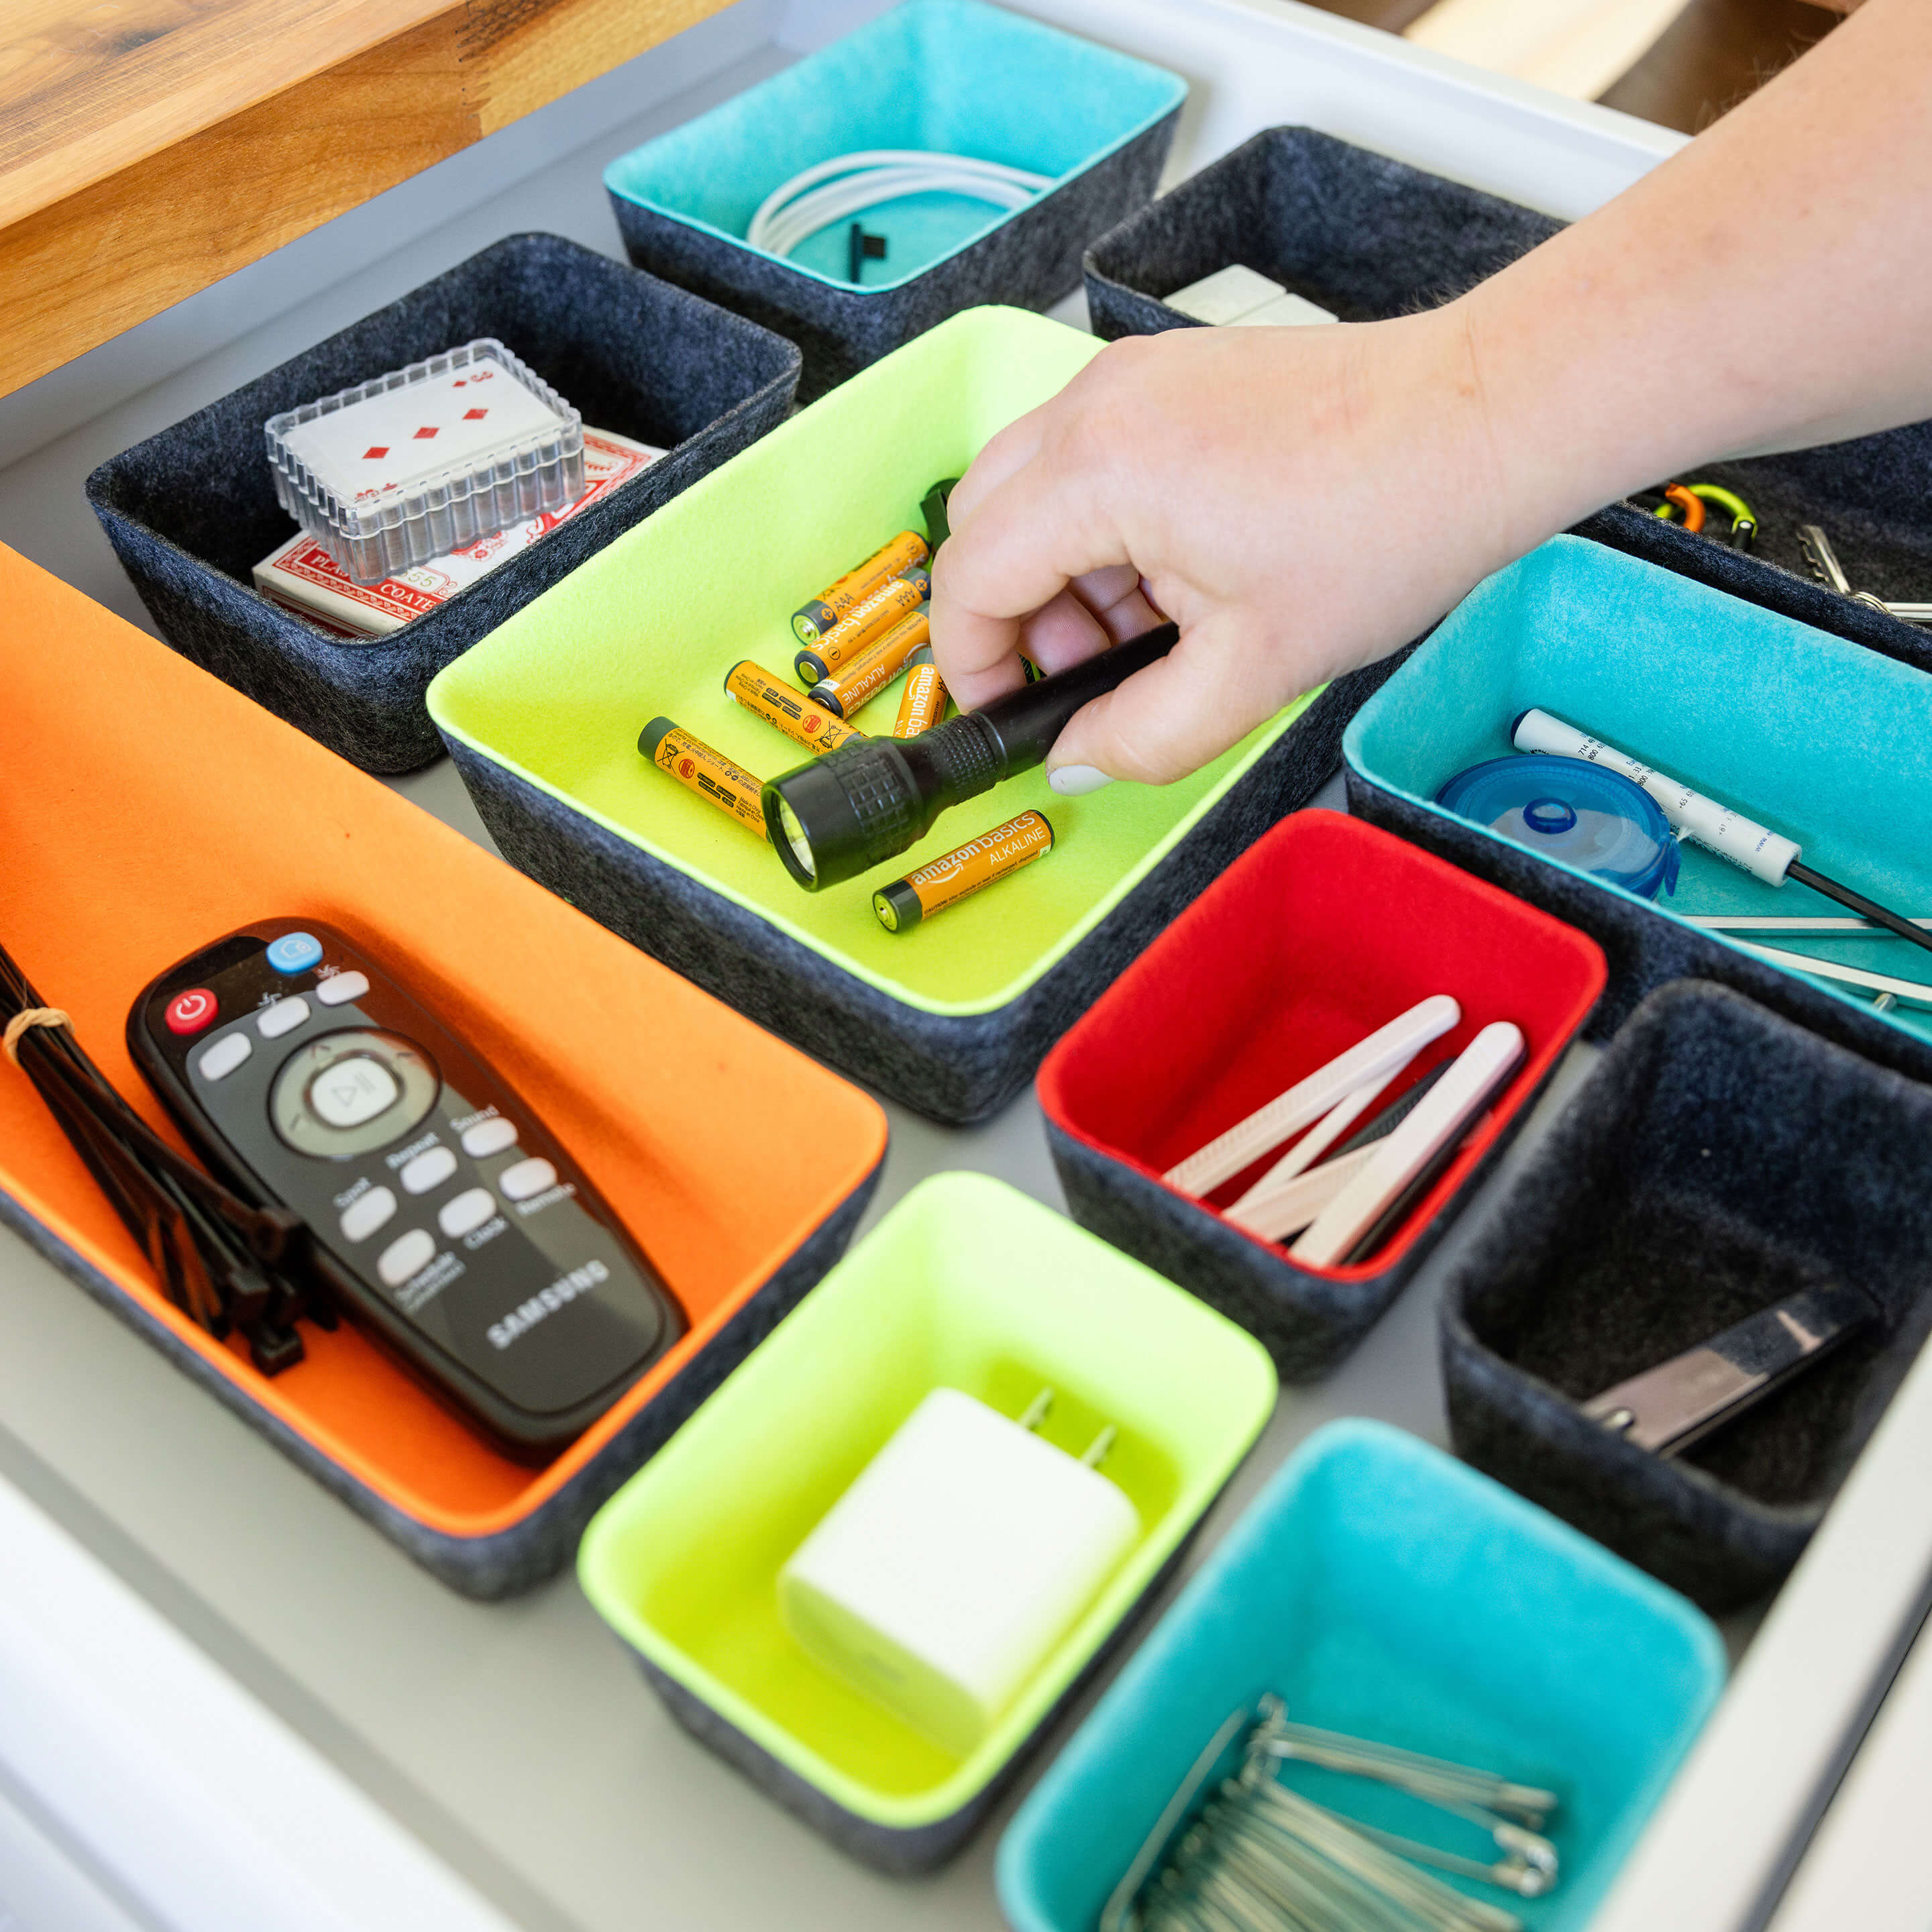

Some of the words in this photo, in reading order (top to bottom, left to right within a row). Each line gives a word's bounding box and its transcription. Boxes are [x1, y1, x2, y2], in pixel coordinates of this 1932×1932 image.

[380, 583, 437, 610] COATE
[835, 593, 855, 611] AAA
[854, 579, 904, 618] amazon
[896, 588, 915, 606] AAA
[810, 616, 861, 651] basics
[841, 663, 885, 705] ALKALINE
[910, 666, 934, 717] amazon
[911, 844, 984, 885] amazon
[976, 814, 1035, 848] basics
[989, 826, 1045, 865] ALKALINE
[486, 1260, 610, 1350] SAMSUNG
